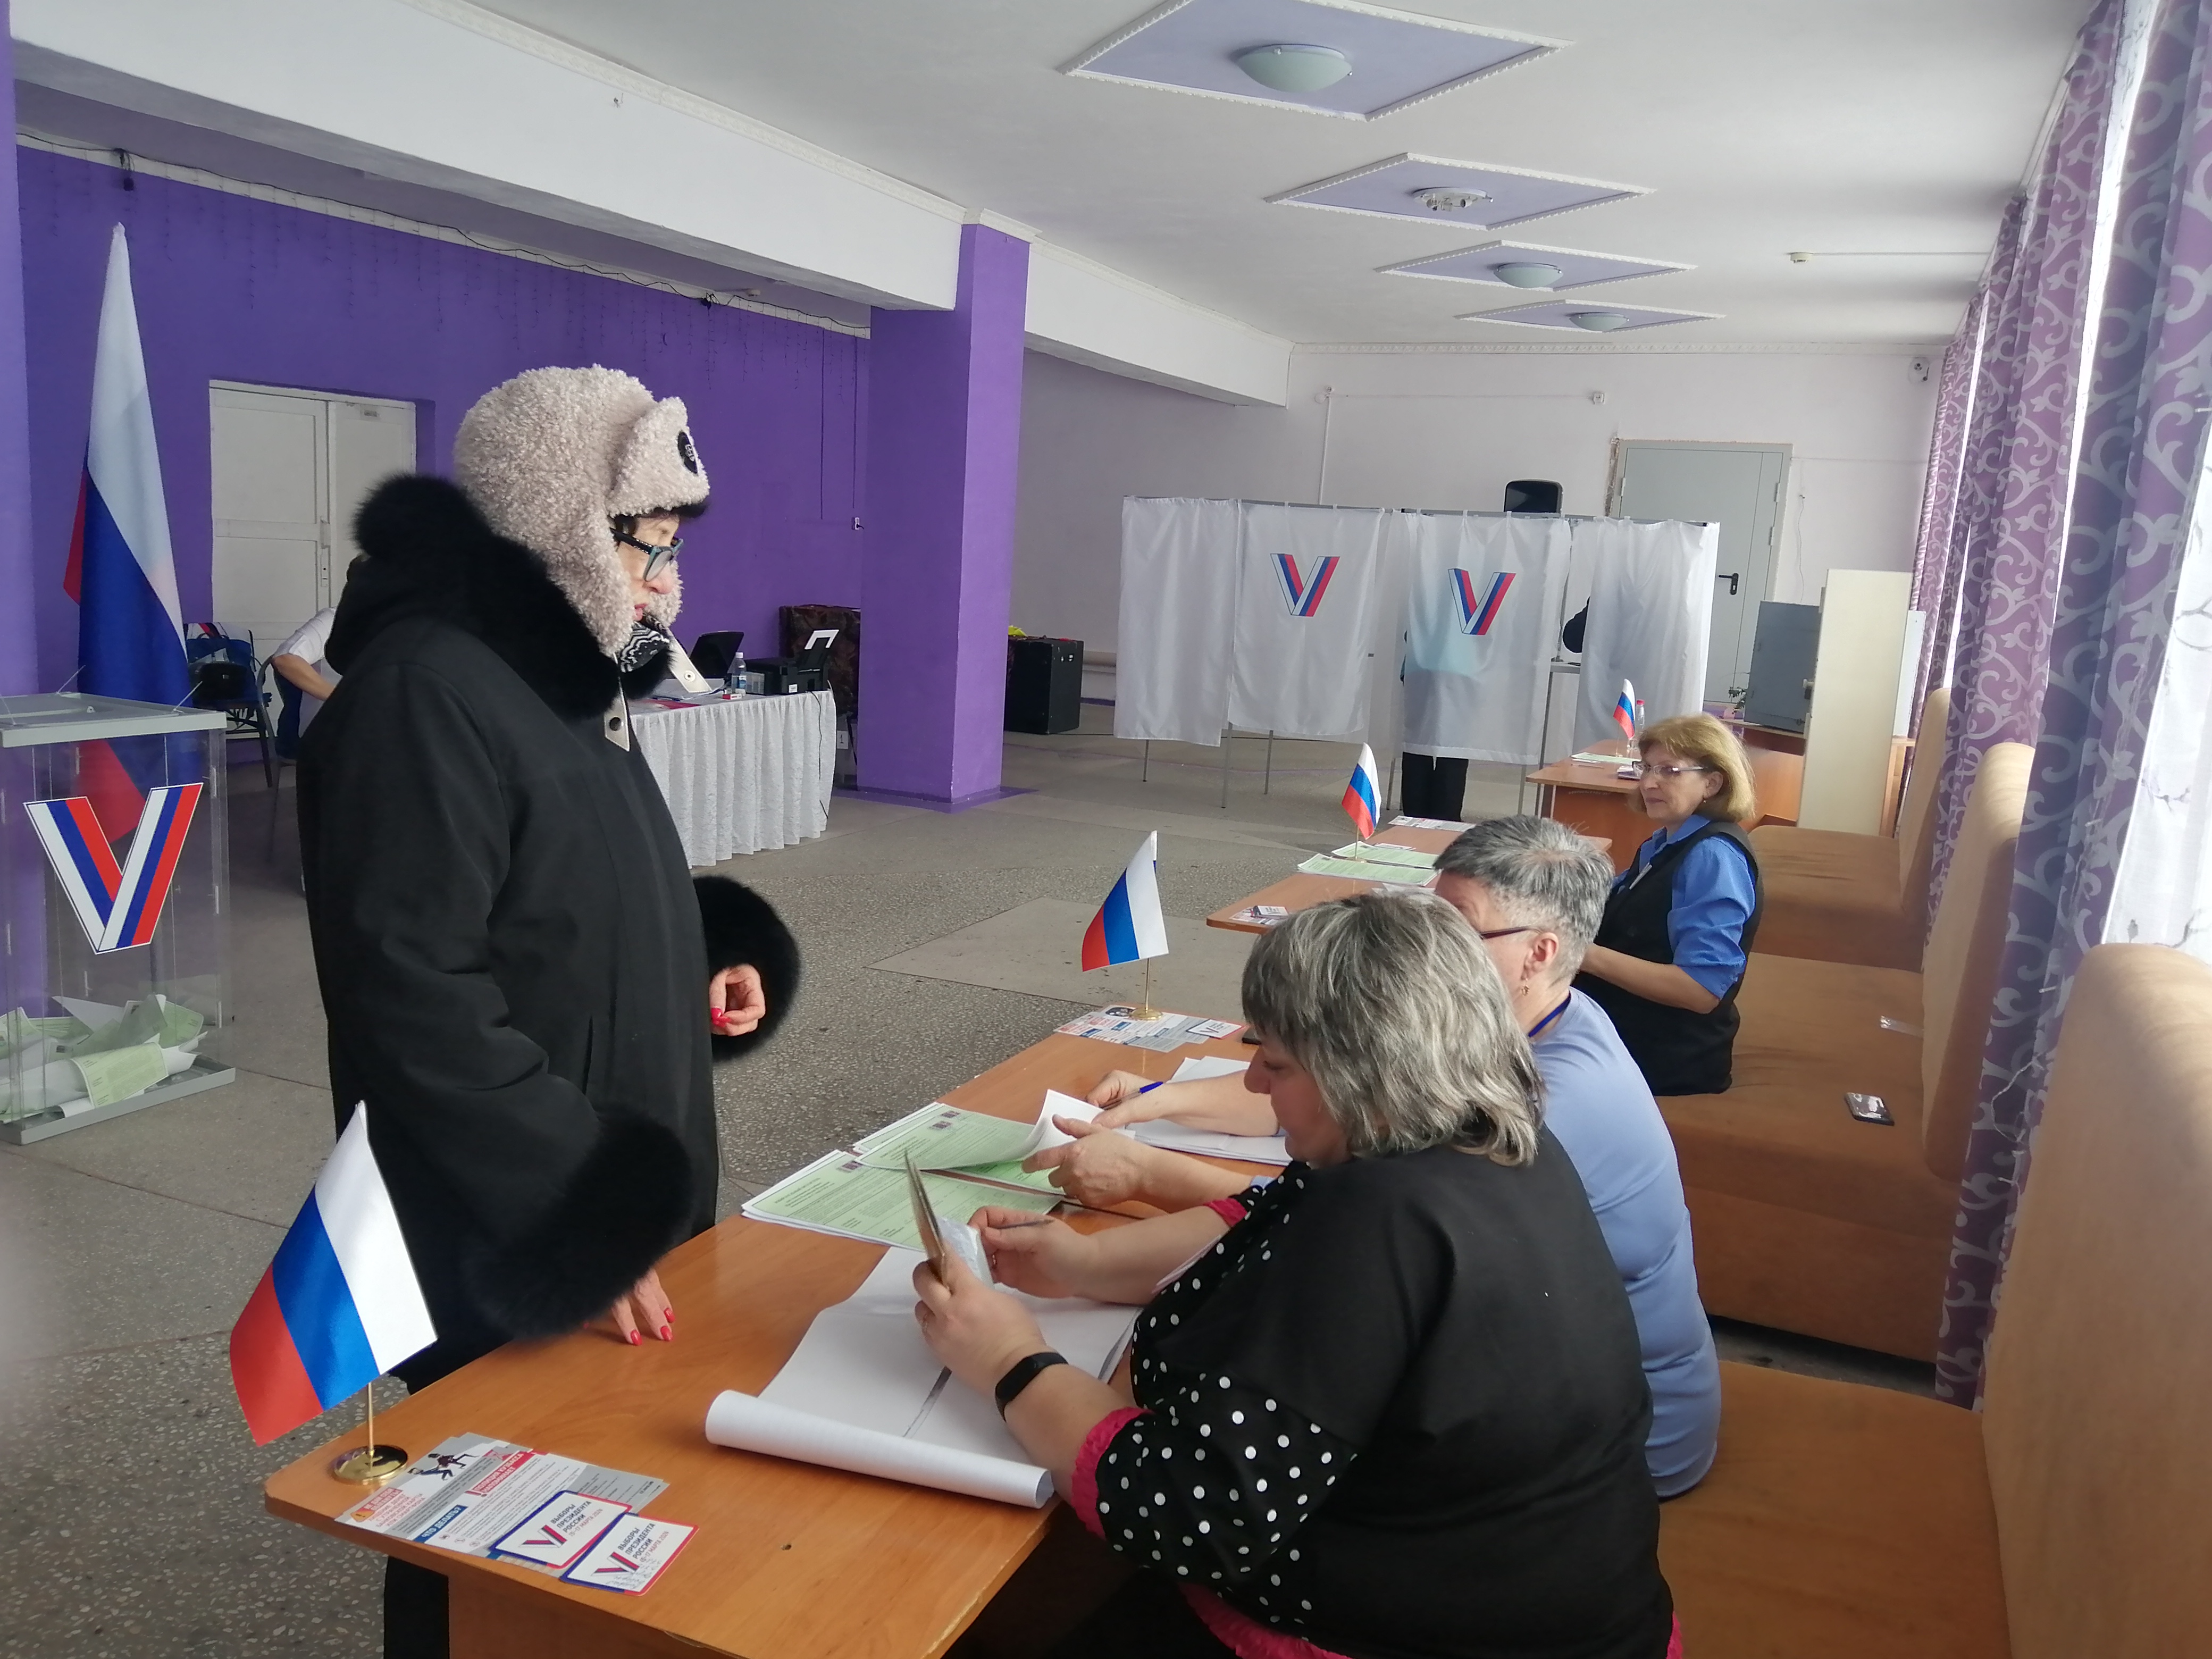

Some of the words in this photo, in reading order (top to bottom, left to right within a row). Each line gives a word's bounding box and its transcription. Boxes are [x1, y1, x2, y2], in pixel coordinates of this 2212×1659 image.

[1270, 553, 1340, 617] V
[1448, 568, 1516, 635] V
[840, 734, 844, 743] 1
[23, 783, 204, 955] V
[421, 1528, 437, 1537] ЧТО
[434, 1507, 462, 1529] ДЕЛАТЬ?
[550, 1504, 576, 1524] ВЫБОРЫ
[557, 1501, 592, 1529] ПРЕЗИДЕНТА
[563, 1514, 586, 1533] РОССИИ
[580, 1515, 594, 1528] МАРТА
[592, 1509, 604, 1517] 2024
[617, 1527, 640, 1551] ВЫБОРЫ
[625, 1523, 656, 1555] ПРЕЗИДЕНТА
[632, 1538, 653, 1560] РОССИИ
[650, 1540, 661, 1553] МАРТА
[660, 1531, 669, 1541] 2024
